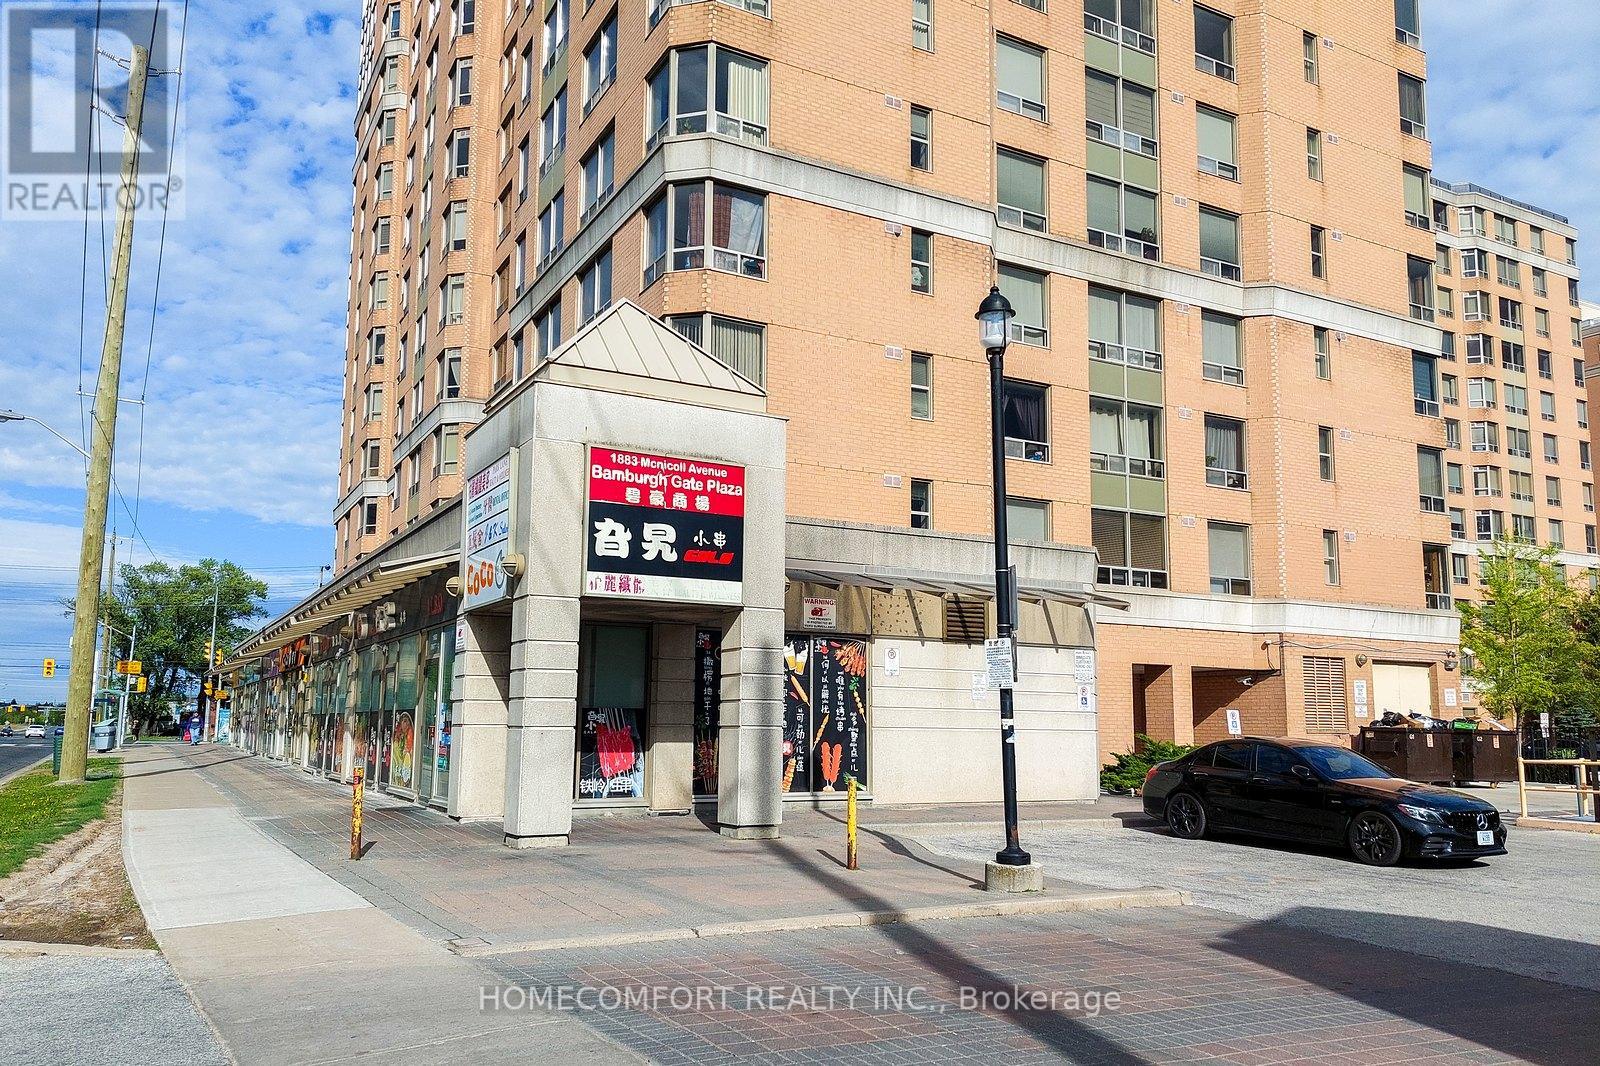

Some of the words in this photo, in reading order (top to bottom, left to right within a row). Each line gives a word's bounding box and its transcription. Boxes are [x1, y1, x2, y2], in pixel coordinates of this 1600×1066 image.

[609, 452, 638, 466] 1883
[640, 457, 686, 472] Mcnicoll
[688, 464, 728, 478] Avenue
[591, 464, 668, 489] Bamburgh
[671, 475, 703, 491] Gate
[706, 480, 743, 496] Plaza
[693, 529, 727, 549] 小串
